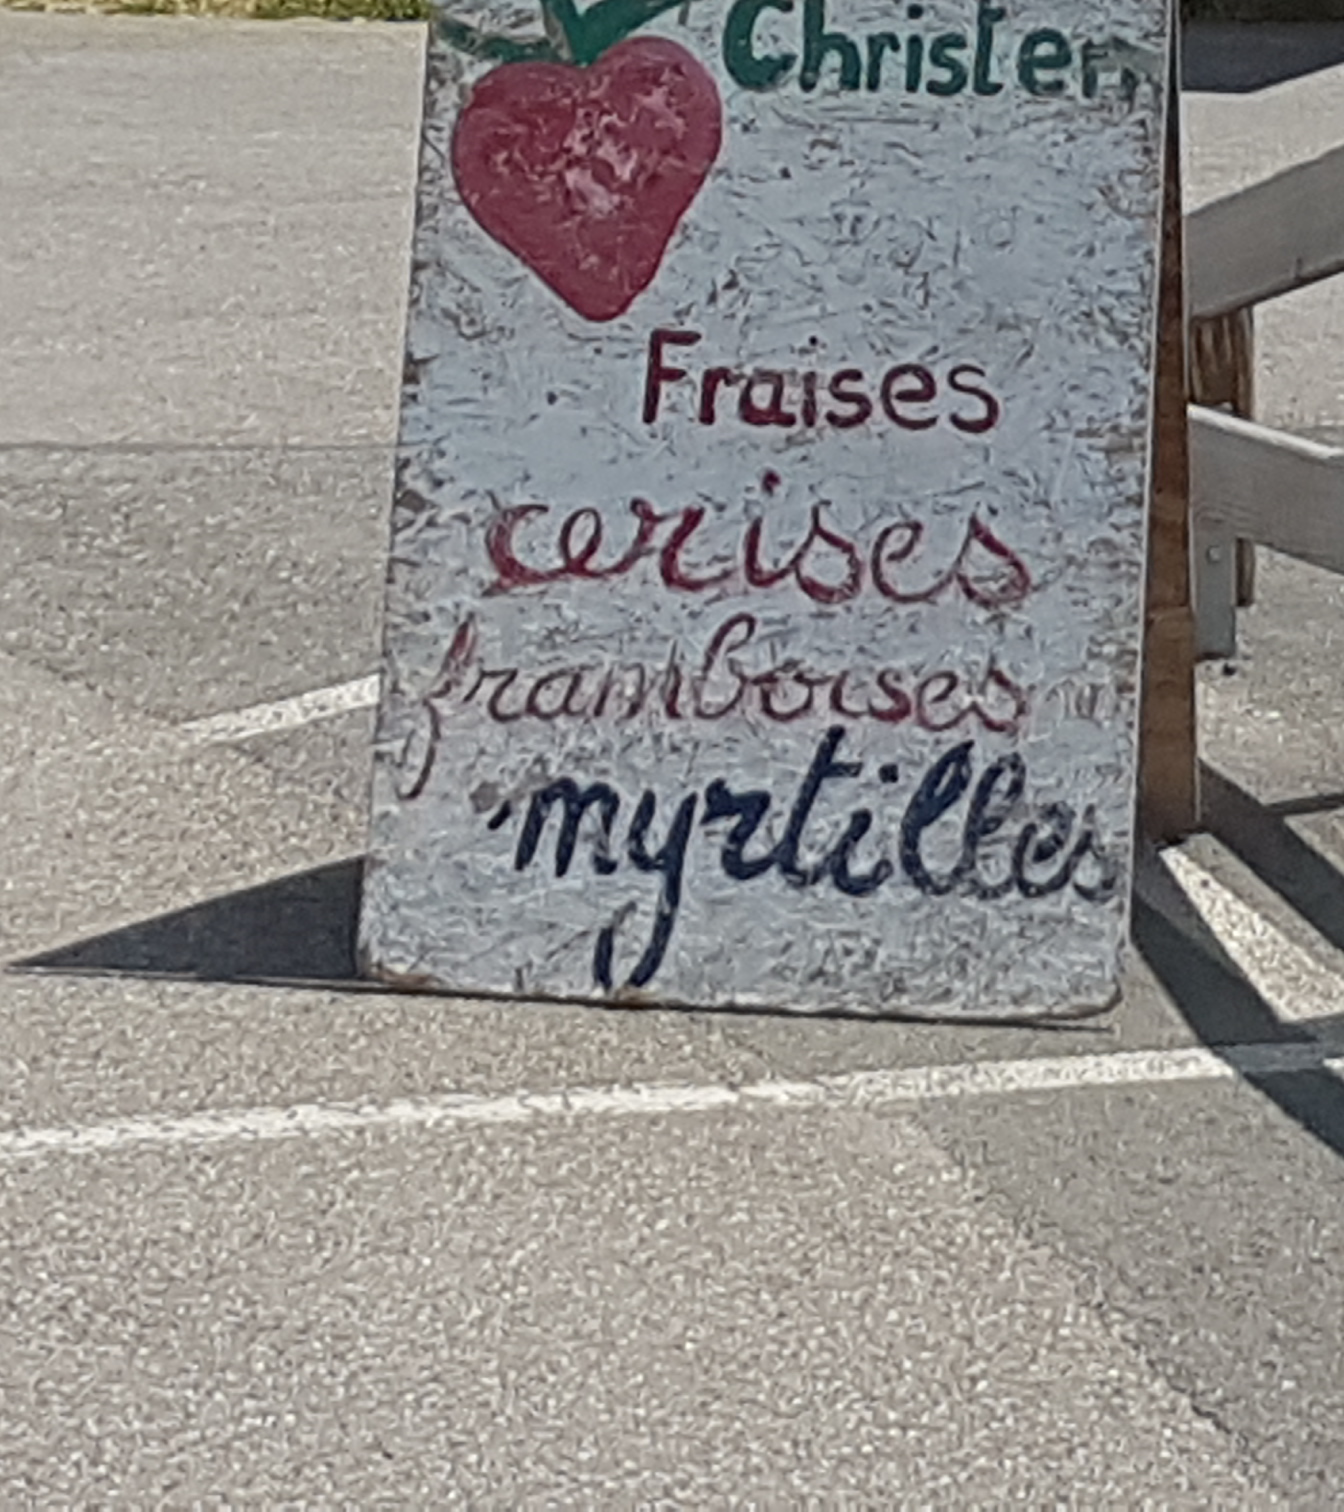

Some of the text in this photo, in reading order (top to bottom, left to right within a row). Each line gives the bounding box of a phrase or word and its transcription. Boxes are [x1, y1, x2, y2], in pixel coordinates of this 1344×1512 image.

[641, 328, 1001, 435] Fraises
[482, 469, 1035, 609] cerises
[394, 613, 1029, 800] framboises
[487, 724, 1117, 990] myrtilles
